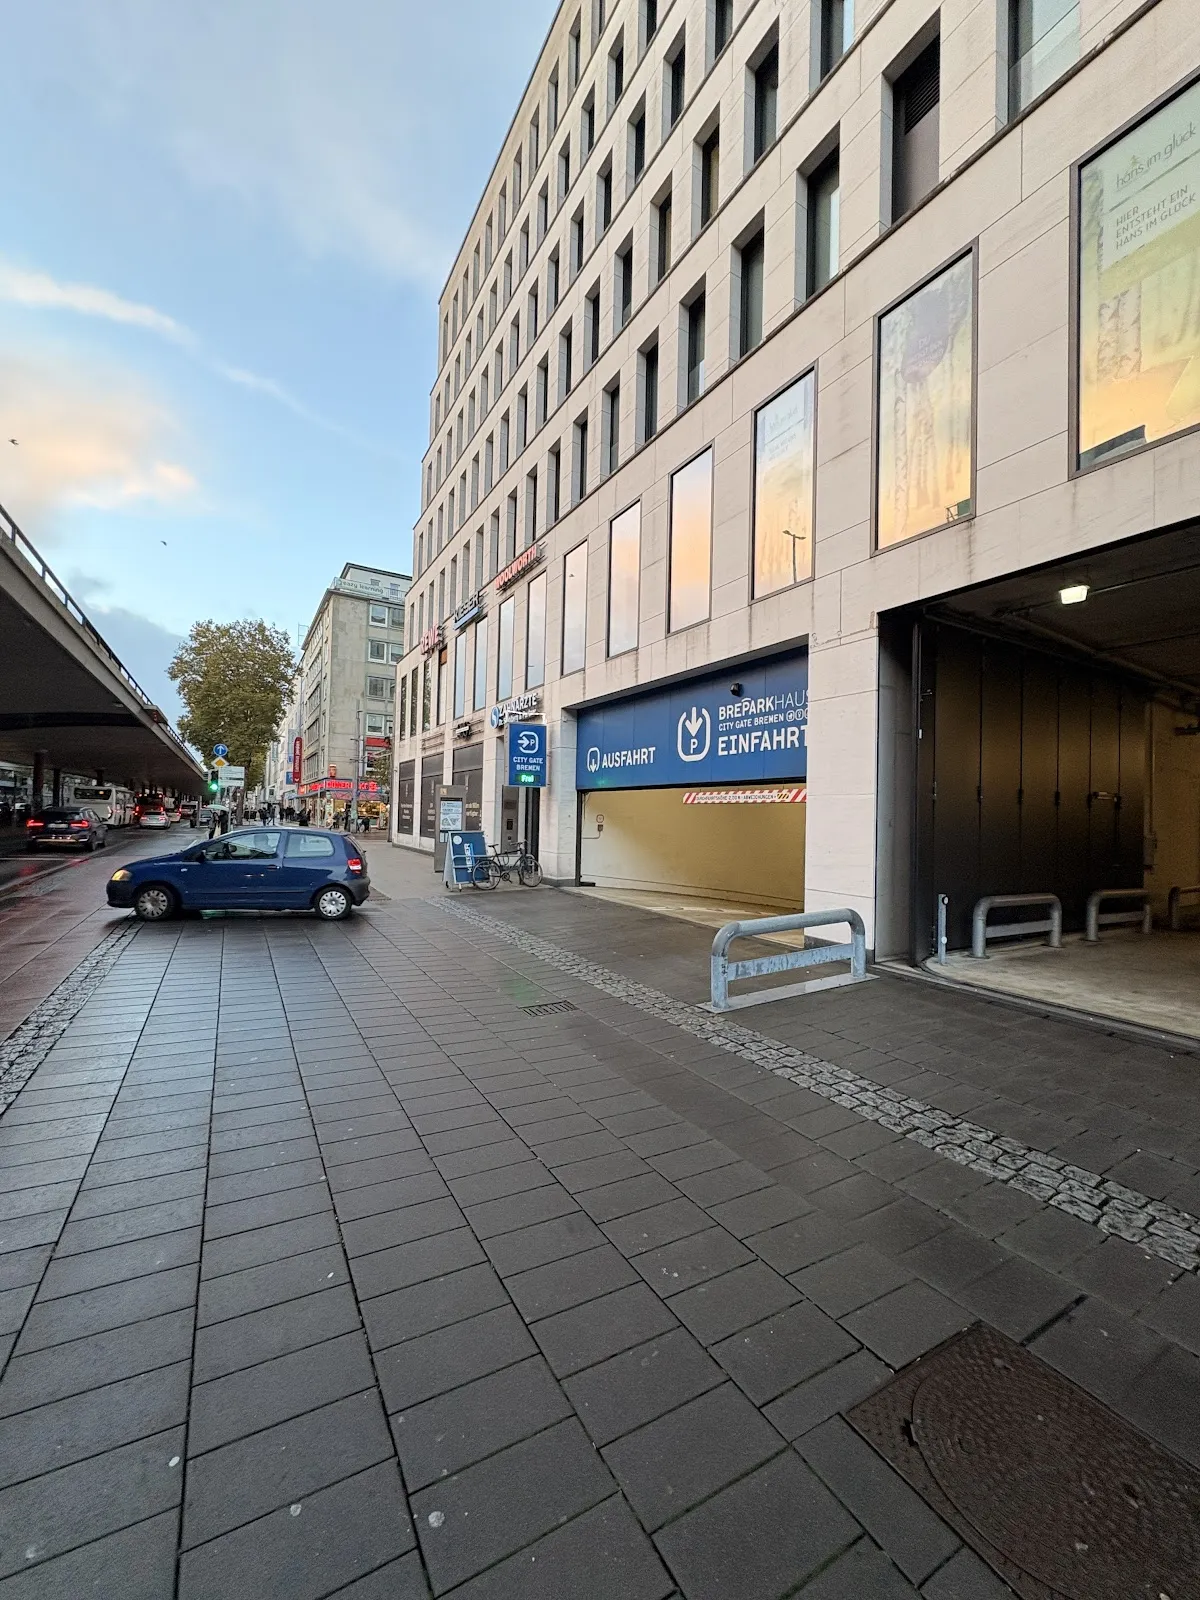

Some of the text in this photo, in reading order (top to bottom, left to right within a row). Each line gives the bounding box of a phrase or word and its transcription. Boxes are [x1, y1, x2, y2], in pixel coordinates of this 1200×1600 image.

[1116, 163, 1144, 189] hans
[1146, 151, 1161, 168] im
[1116, 184, 1188, 239] ENTSTEHT EIN
[1116, 205, 1139, 228] HIER
[1116, 226, 1143, 250] HANS
[1146, 219, 1158, 234] IM
[495, 543, 537, 590] WOOLWORTH
[420, 624, 441, 654] REWE
[718, 713, 784, 731] CITY GATE BREMEN
[718, 724, 808, 756] EINFAHRT
[601, 746, 656, 769] AUSFAHRT
